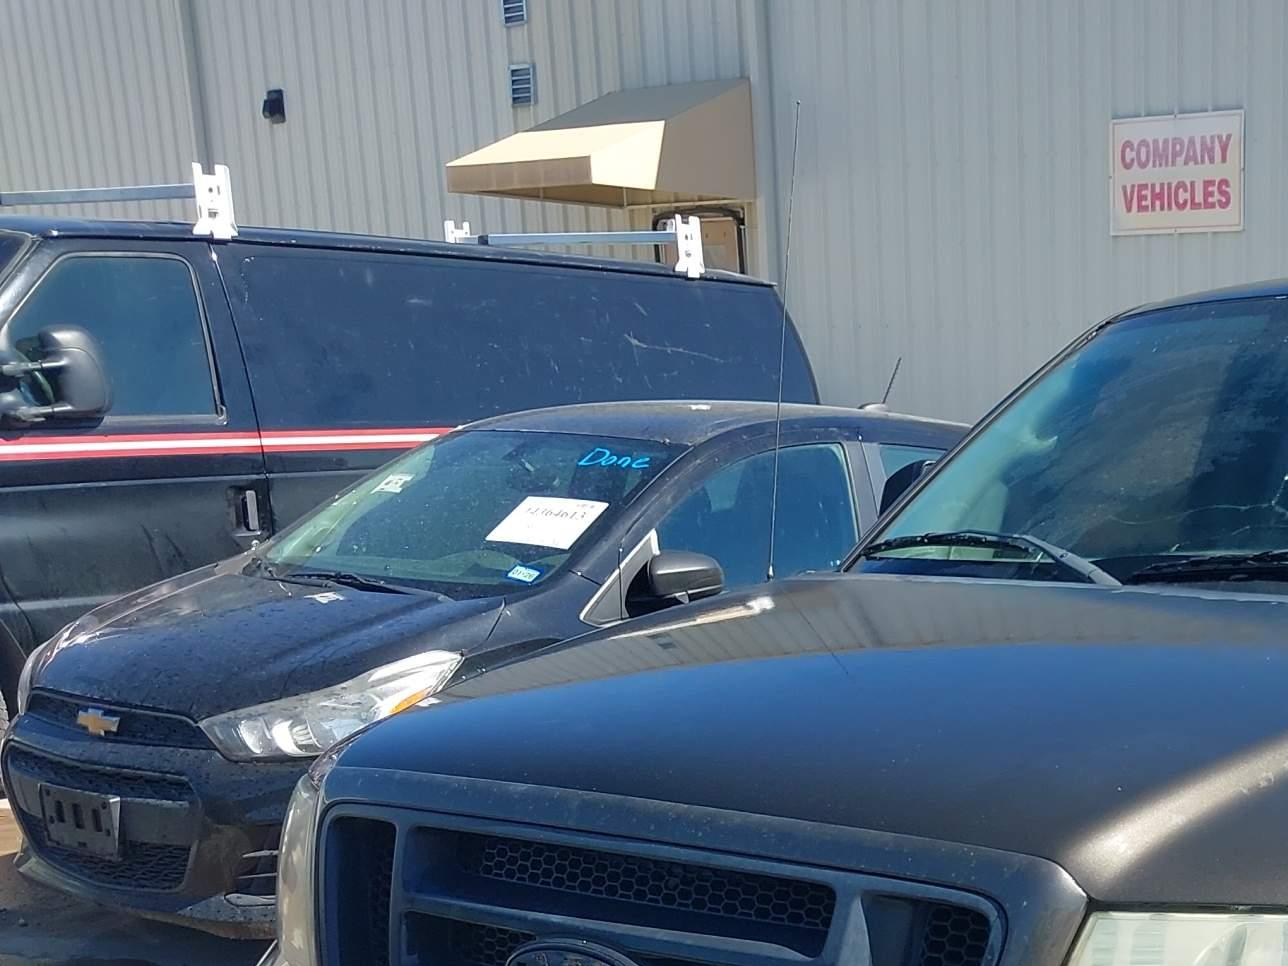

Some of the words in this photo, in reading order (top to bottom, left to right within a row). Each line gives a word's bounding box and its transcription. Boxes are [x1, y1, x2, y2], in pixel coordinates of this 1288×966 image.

[1120, 133, 1233, 170] COMPANY
[1121, 178, 1232, 214] VEHICLES
[578, 447, 650, 468] Done
